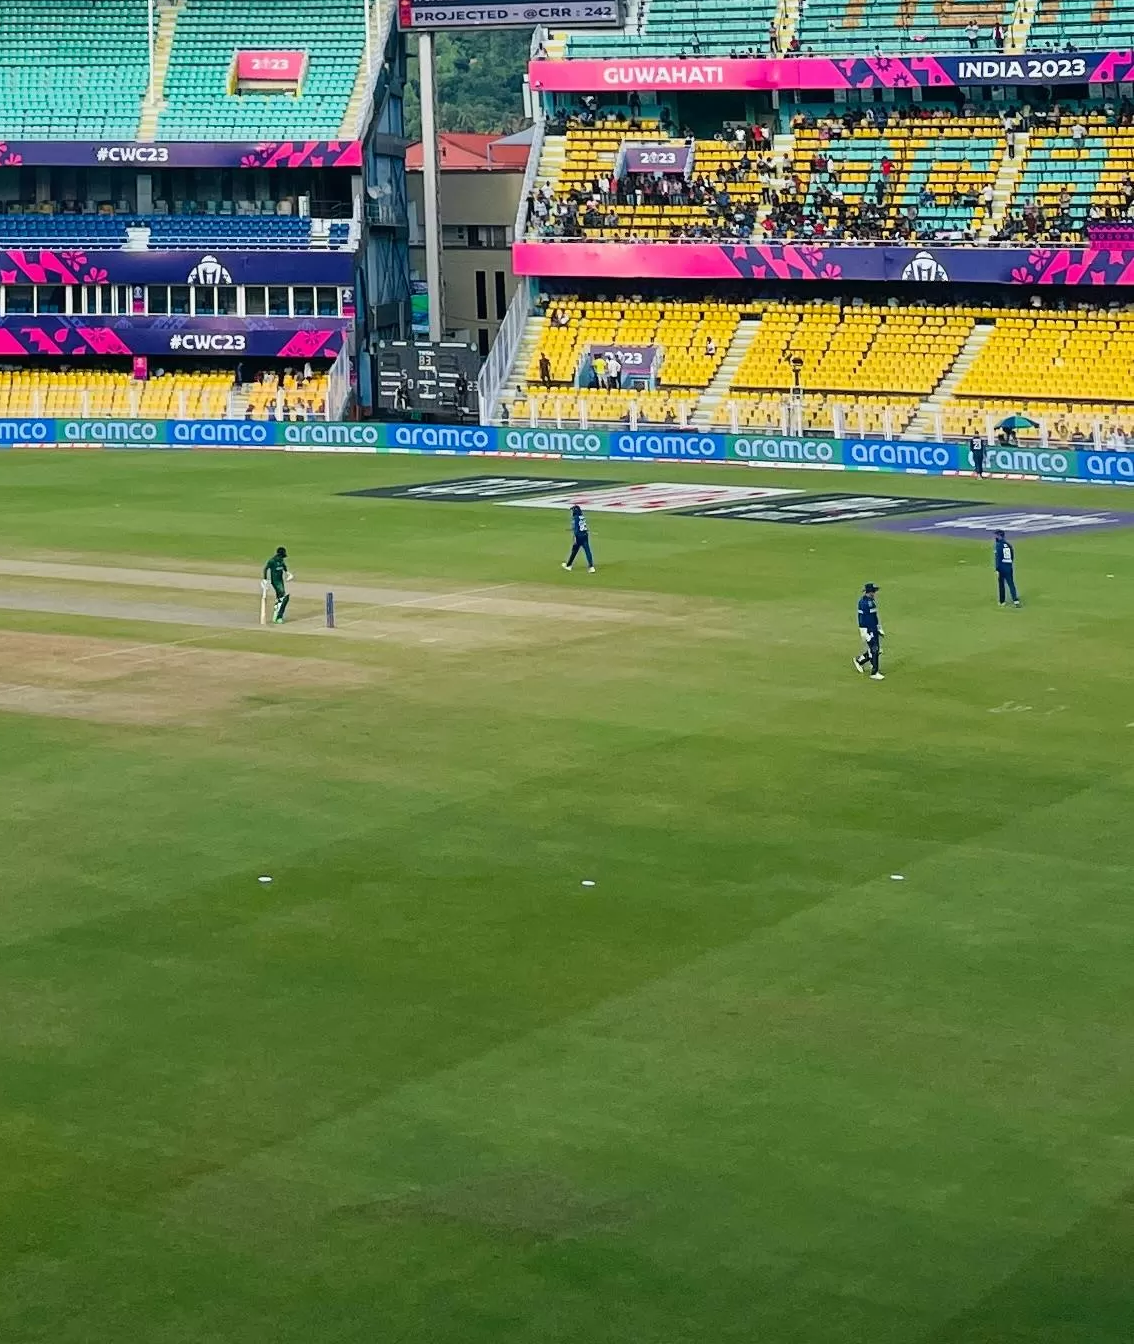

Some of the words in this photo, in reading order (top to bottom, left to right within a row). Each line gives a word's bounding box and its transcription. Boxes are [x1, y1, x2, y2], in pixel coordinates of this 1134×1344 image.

[415, 9, 508, 22] PROJECTED
[523, 6, 572, 20] @CRR
[584, 6, 612, 17] 242
[603, 66, 723, 85] GUWAHATI
[958, 61, 1025, 79] INDIA
[1027, 58, 1086, 78] 2023
[96, 147, 169, 162] #CWC23
[169, 334, 246, 351] #CWC23
[64, 422, 157, 441] aramco
[173, 423, 267, 442] aramco
[284, 424, 379, 444] aramco
[394, 426, 489, 448] aramco
[505, 430, 601, 453] aramco
[617, 432, 716, 456] aramco
[733, 437, 833, 462] aramco
[850, 441, 950, 467] aramco
